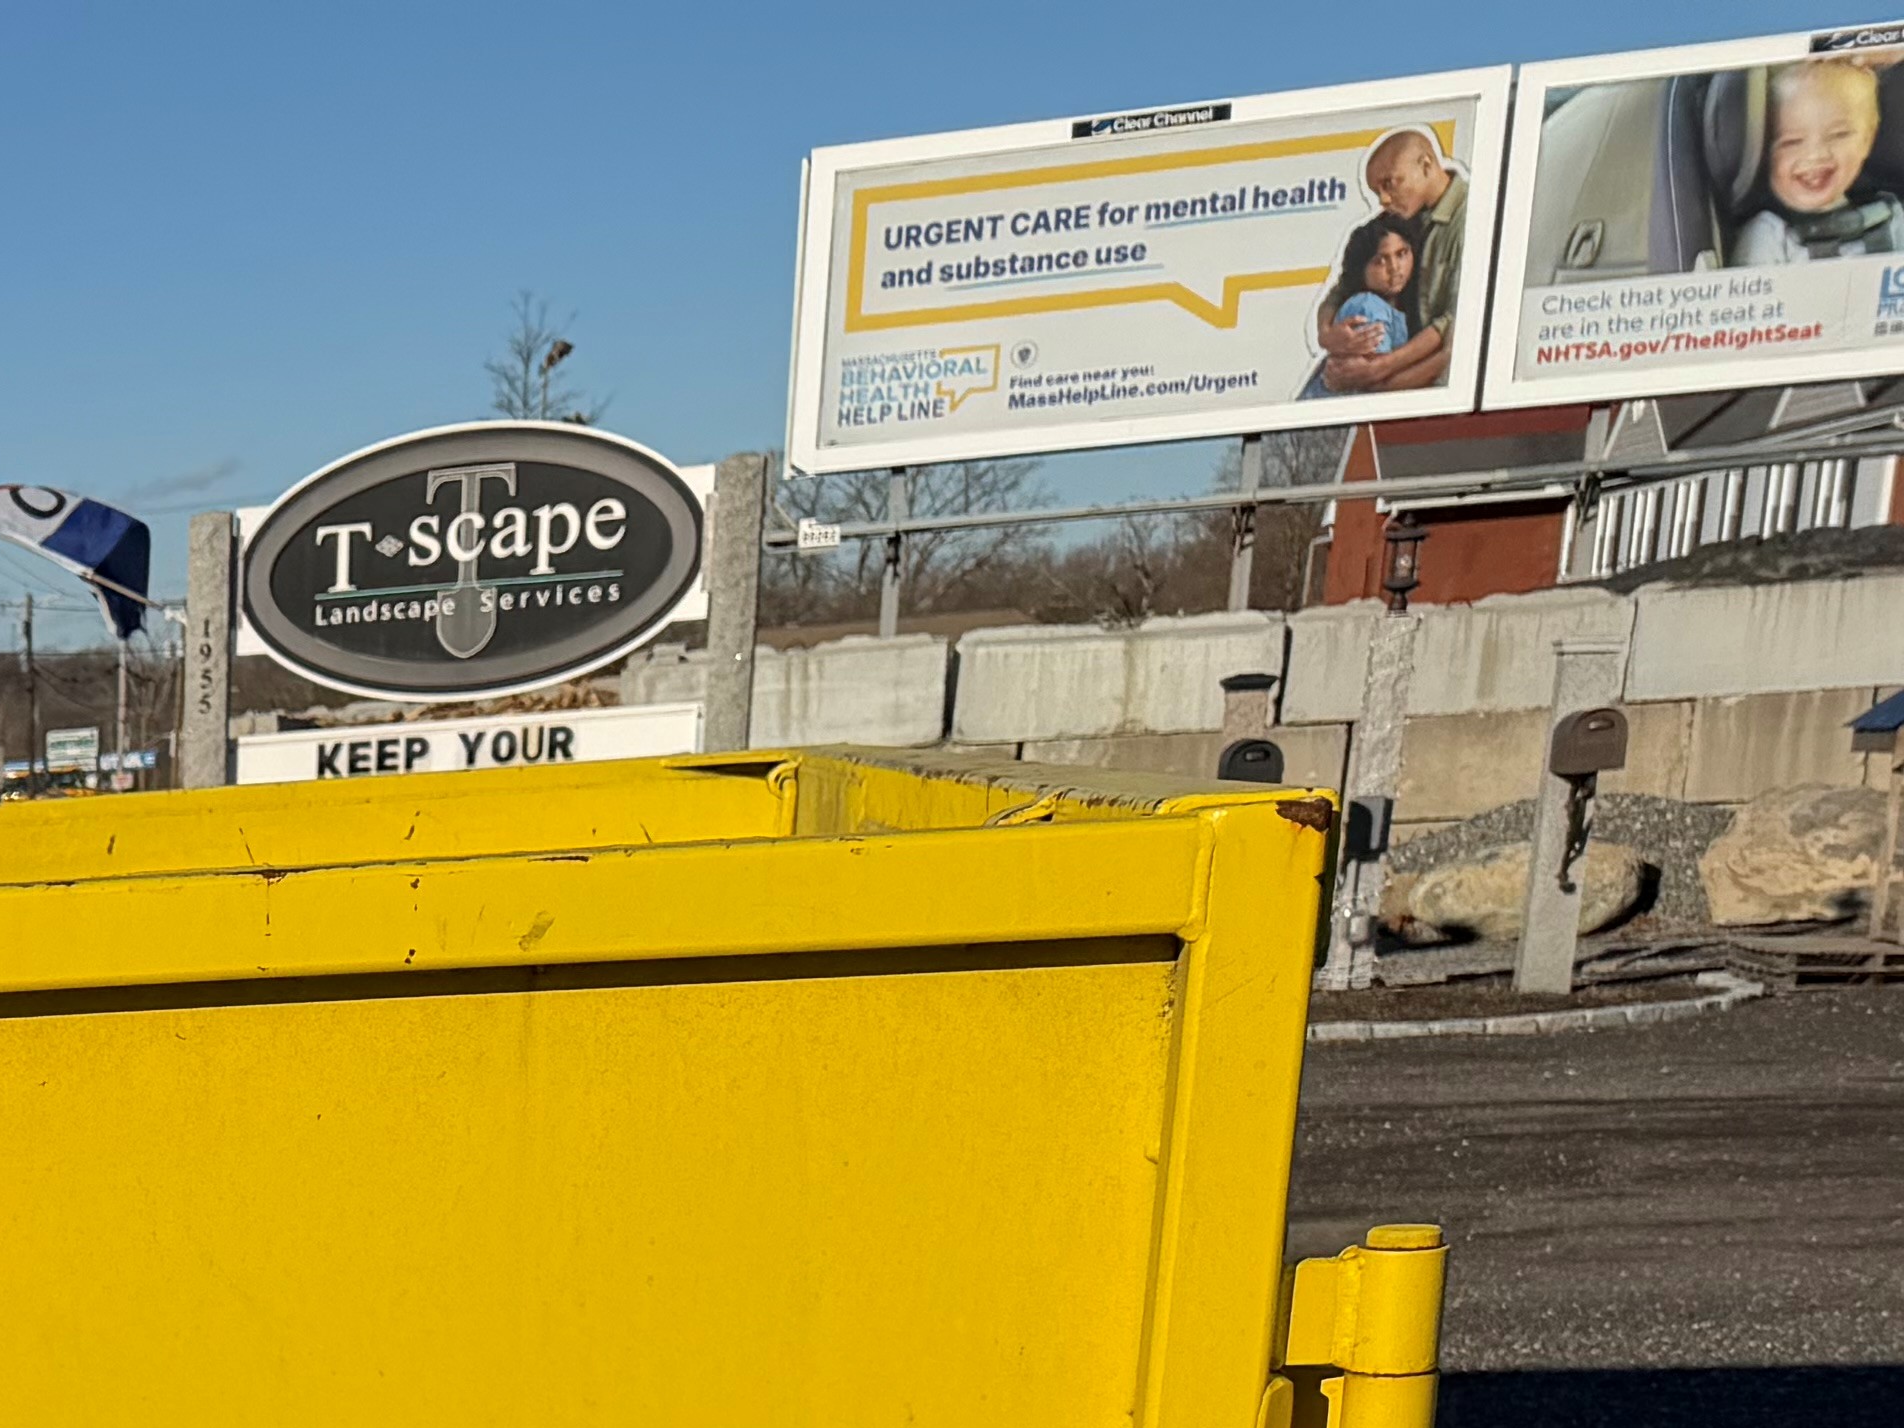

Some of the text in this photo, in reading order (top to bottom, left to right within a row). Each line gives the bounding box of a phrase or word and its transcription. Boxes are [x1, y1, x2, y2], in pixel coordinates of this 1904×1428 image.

[1112, 106, 1213, 133] Clear Channel
[883, 176, 1348, 252] URGENT CARE for mental health
[880, 241, 1147, 290] and substance use
[1542, 276, 1773, 315] Check that your kids
[1538, 300, 1785, 341] are in the right seat at
[1536, 321, 1824, 365] NHTSA.gov/TheRightSeat
[841, 356, 989, 387] BEHAVIORAL
[1008, 370, 1259, 410] MassHelpLine.com/Urgent
[1009, 364, 1155, 389] Find care near you!
[837, 398, 946, 428] HELP LINE
[839, 382, 930, 406] HEALTH
[314, 579, 622, 627] Landscape Services
[316, 725, 575, 778] KEEP YOUR
